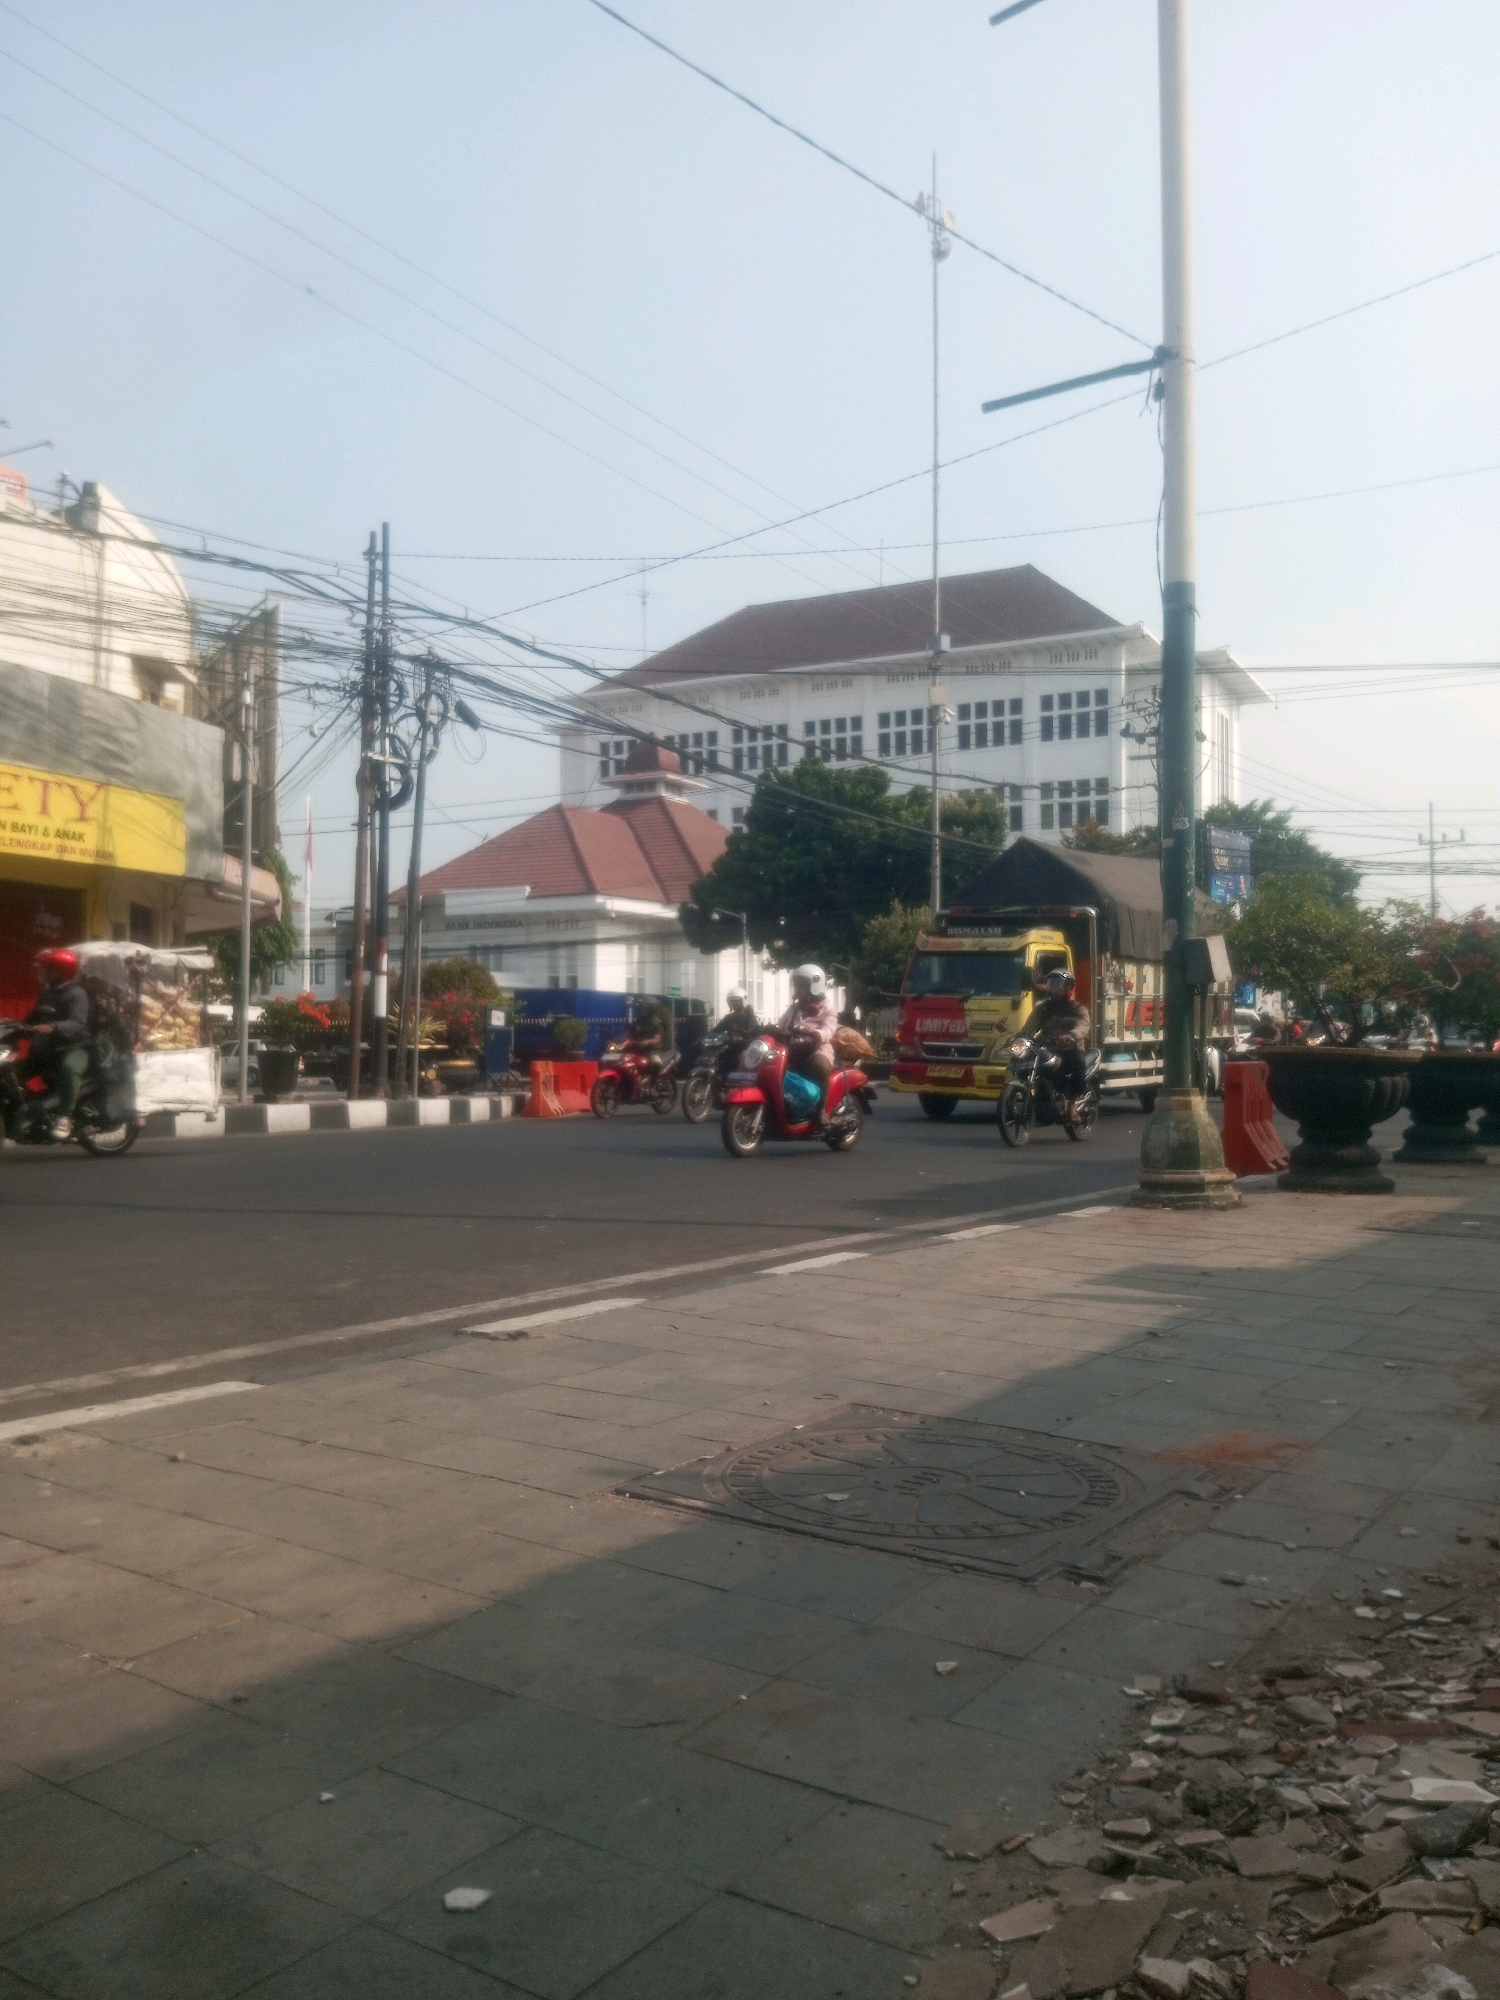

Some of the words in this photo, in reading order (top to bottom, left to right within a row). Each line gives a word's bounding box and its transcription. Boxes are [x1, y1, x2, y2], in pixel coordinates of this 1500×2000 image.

[11, 821, 38, 837] BAYI
[42, 827, 50, 837] &
[54, 828, 86, 843] ANAK
[57, 844, 77, 855] DAN
[445, 921, 469, 931] BANK
